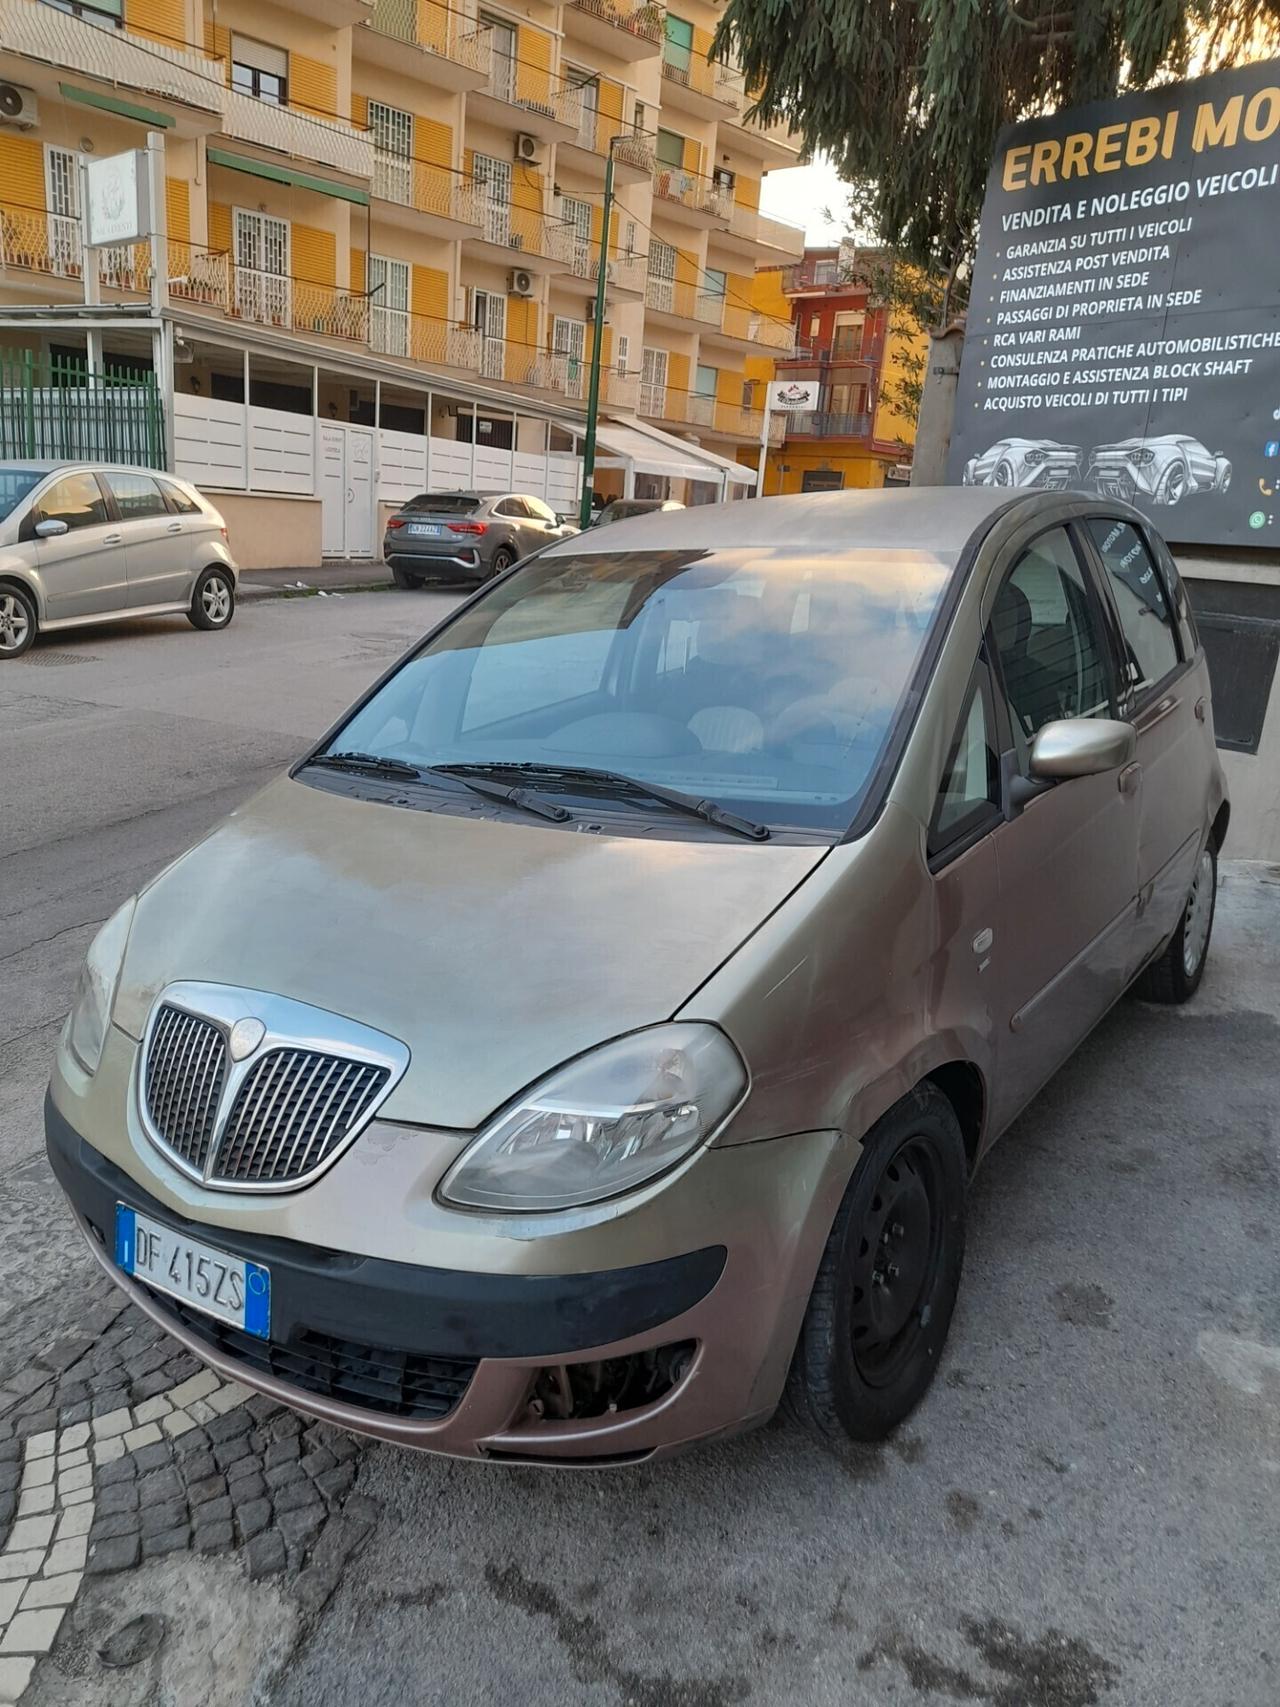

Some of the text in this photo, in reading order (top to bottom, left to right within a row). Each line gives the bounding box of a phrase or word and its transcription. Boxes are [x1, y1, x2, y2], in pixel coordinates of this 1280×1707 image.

[1002, 110, 1179, 191] ERREBI
[1002, 163, 1278, 231] VENDITA E NOLEGGIO VEICOLI
[1006, 217, 1193, 259] GARANZIA SU TUTTI I VEICOLI
[1002, 245, 1170, 282] ASSISTENZA POST VENDITA
[999, 272, 1150, 304] FINANZIAMENTI IN SEDE
[996, 289, 1203, 325] PASSAGGI DI PROPRIETA IN SEDE
[990, 332, 1280, 368] CONSULENZA PRATICHE AUTOMOBILISTICHE
[993, 326, 1081, 347] RCA VARI RAMI
[987, 359, 1253, 389] MONTAGGIO E ASSISTENZA BLOCK SHAFT
[983, 387, 1188, 411] ACQUISTO VEICOLI DI TUTTI I TIPI
[136, 1226, 245, 1311] DF 415ZS
